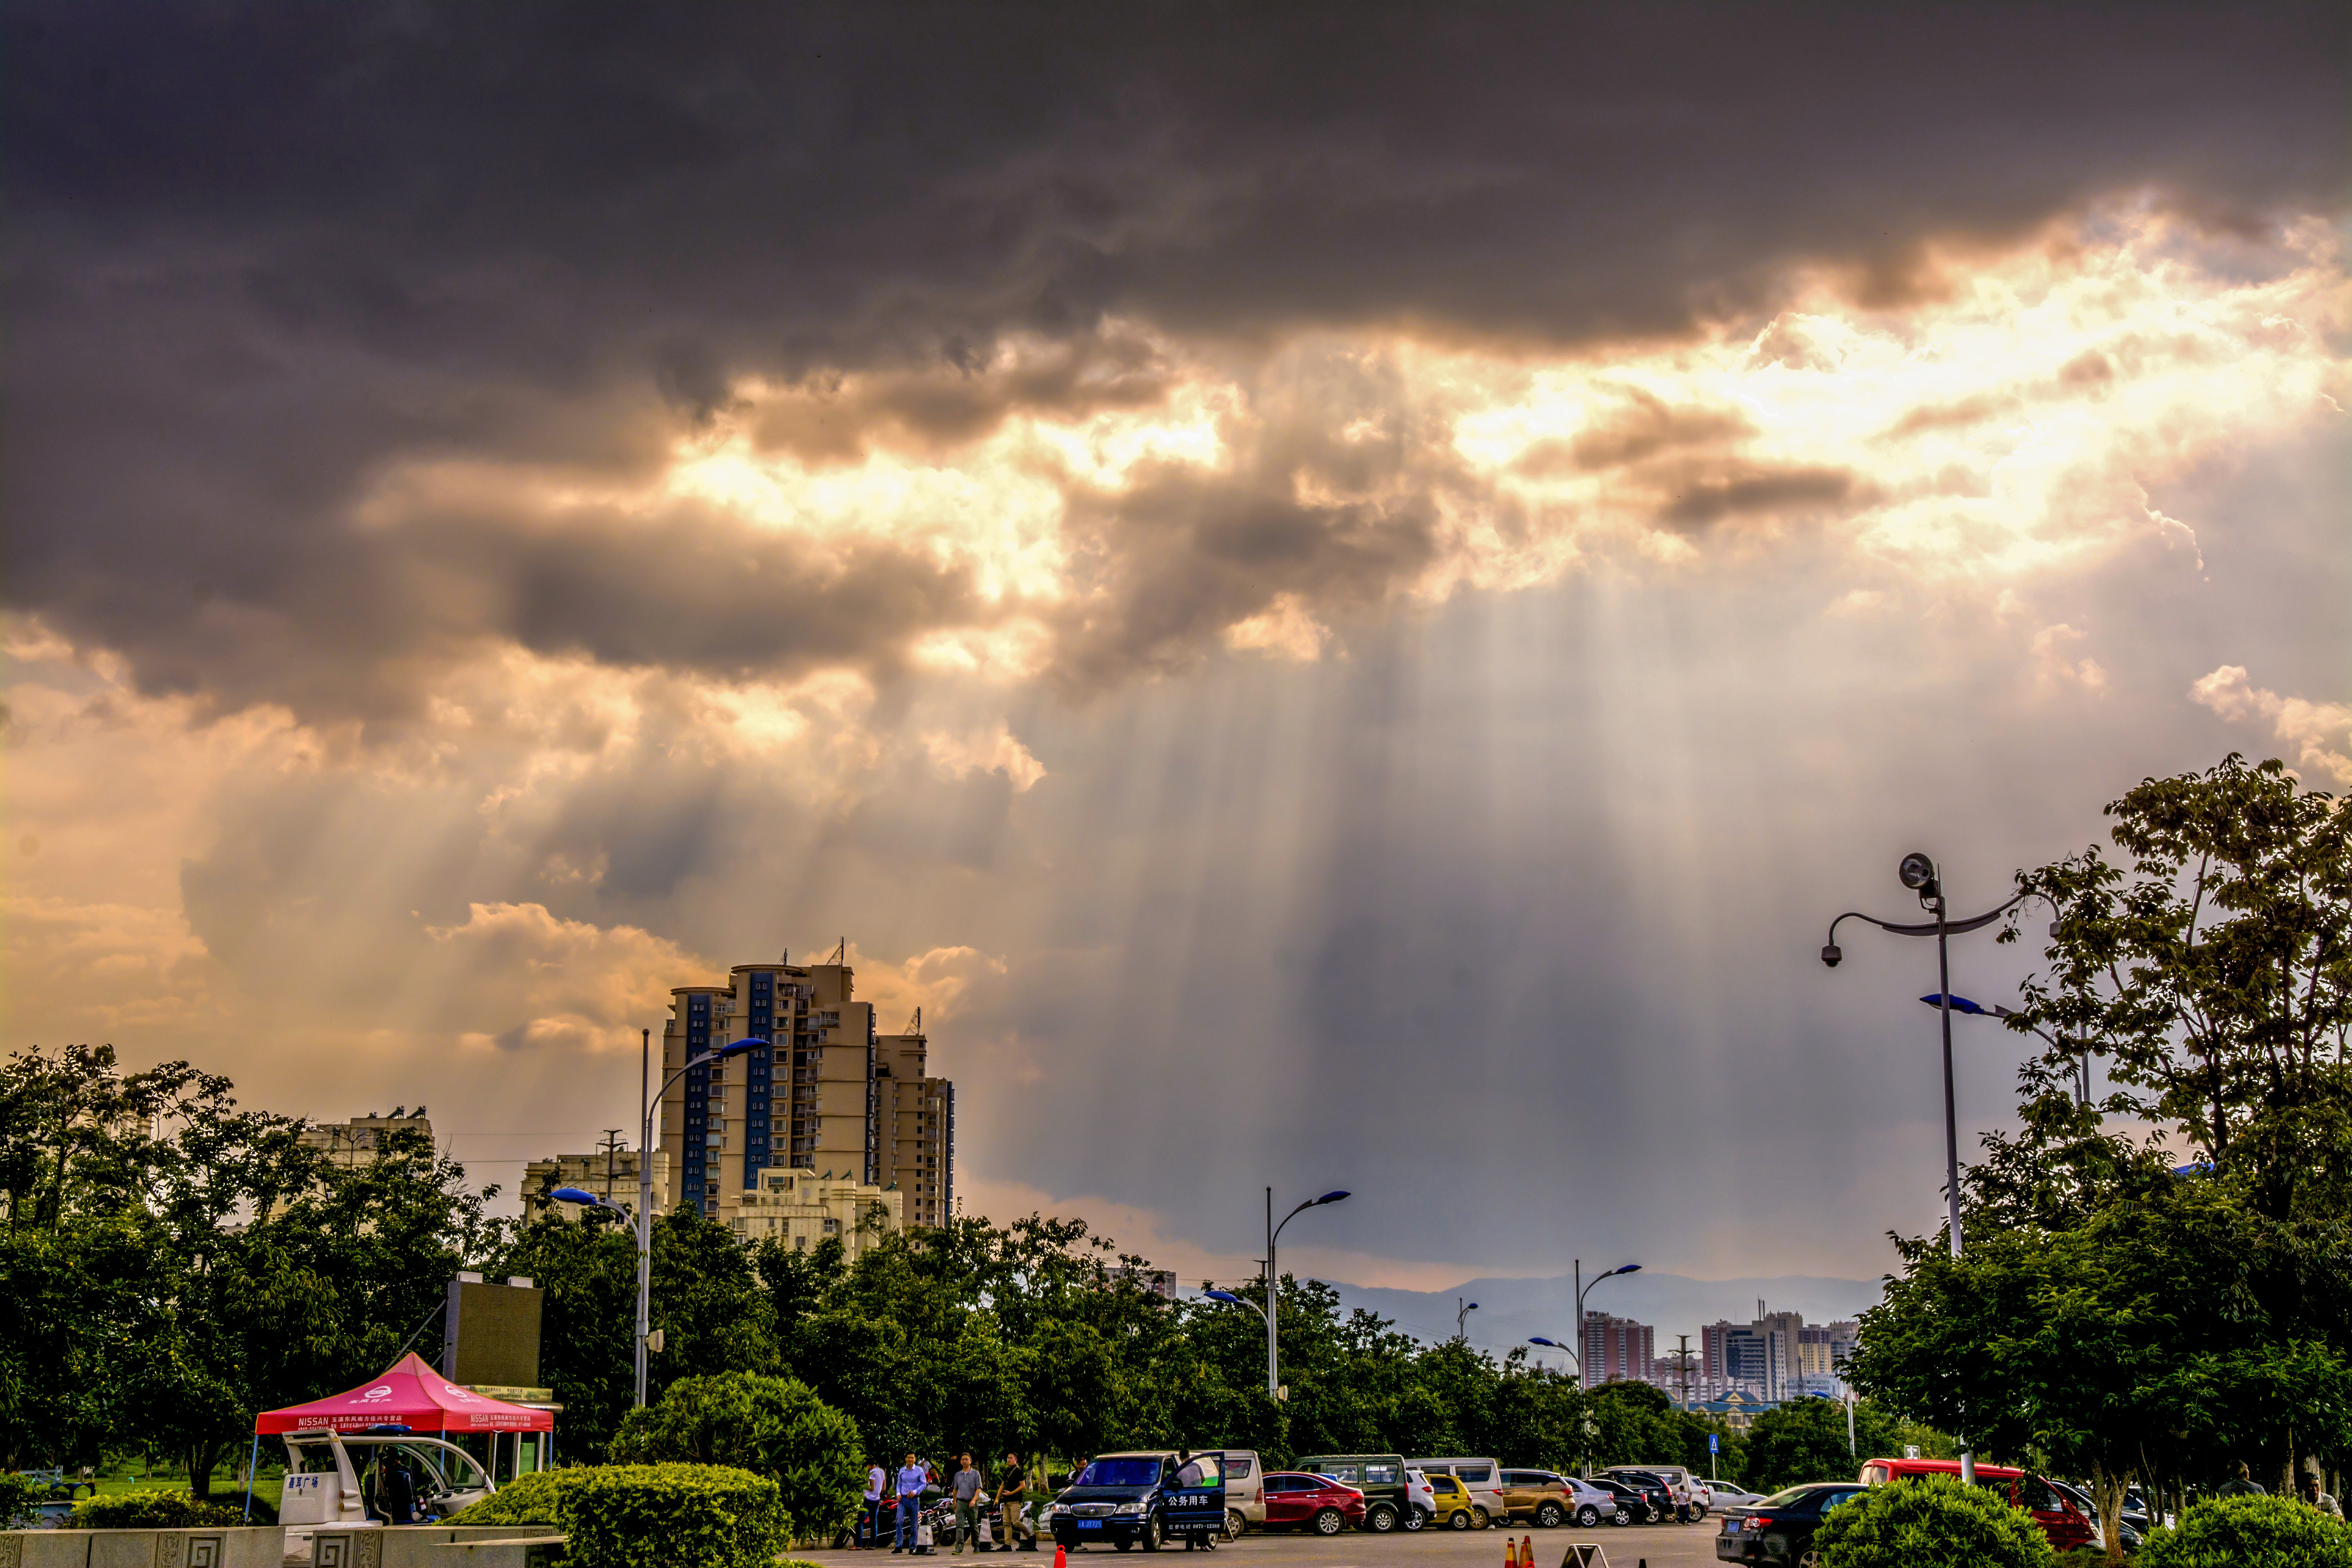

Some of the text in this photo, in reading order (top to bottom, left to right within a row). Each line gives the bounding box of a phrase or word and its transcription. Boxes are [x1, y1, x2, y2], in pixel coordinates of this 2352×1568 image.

[299, 1417, 328, 1426] NISSAN
[470, 1414, 488, 1423] NISSAN
[289, 1476, 318, 1488] 聂耳广场
[1168, 1495, 1208, 1506] 公务用车
